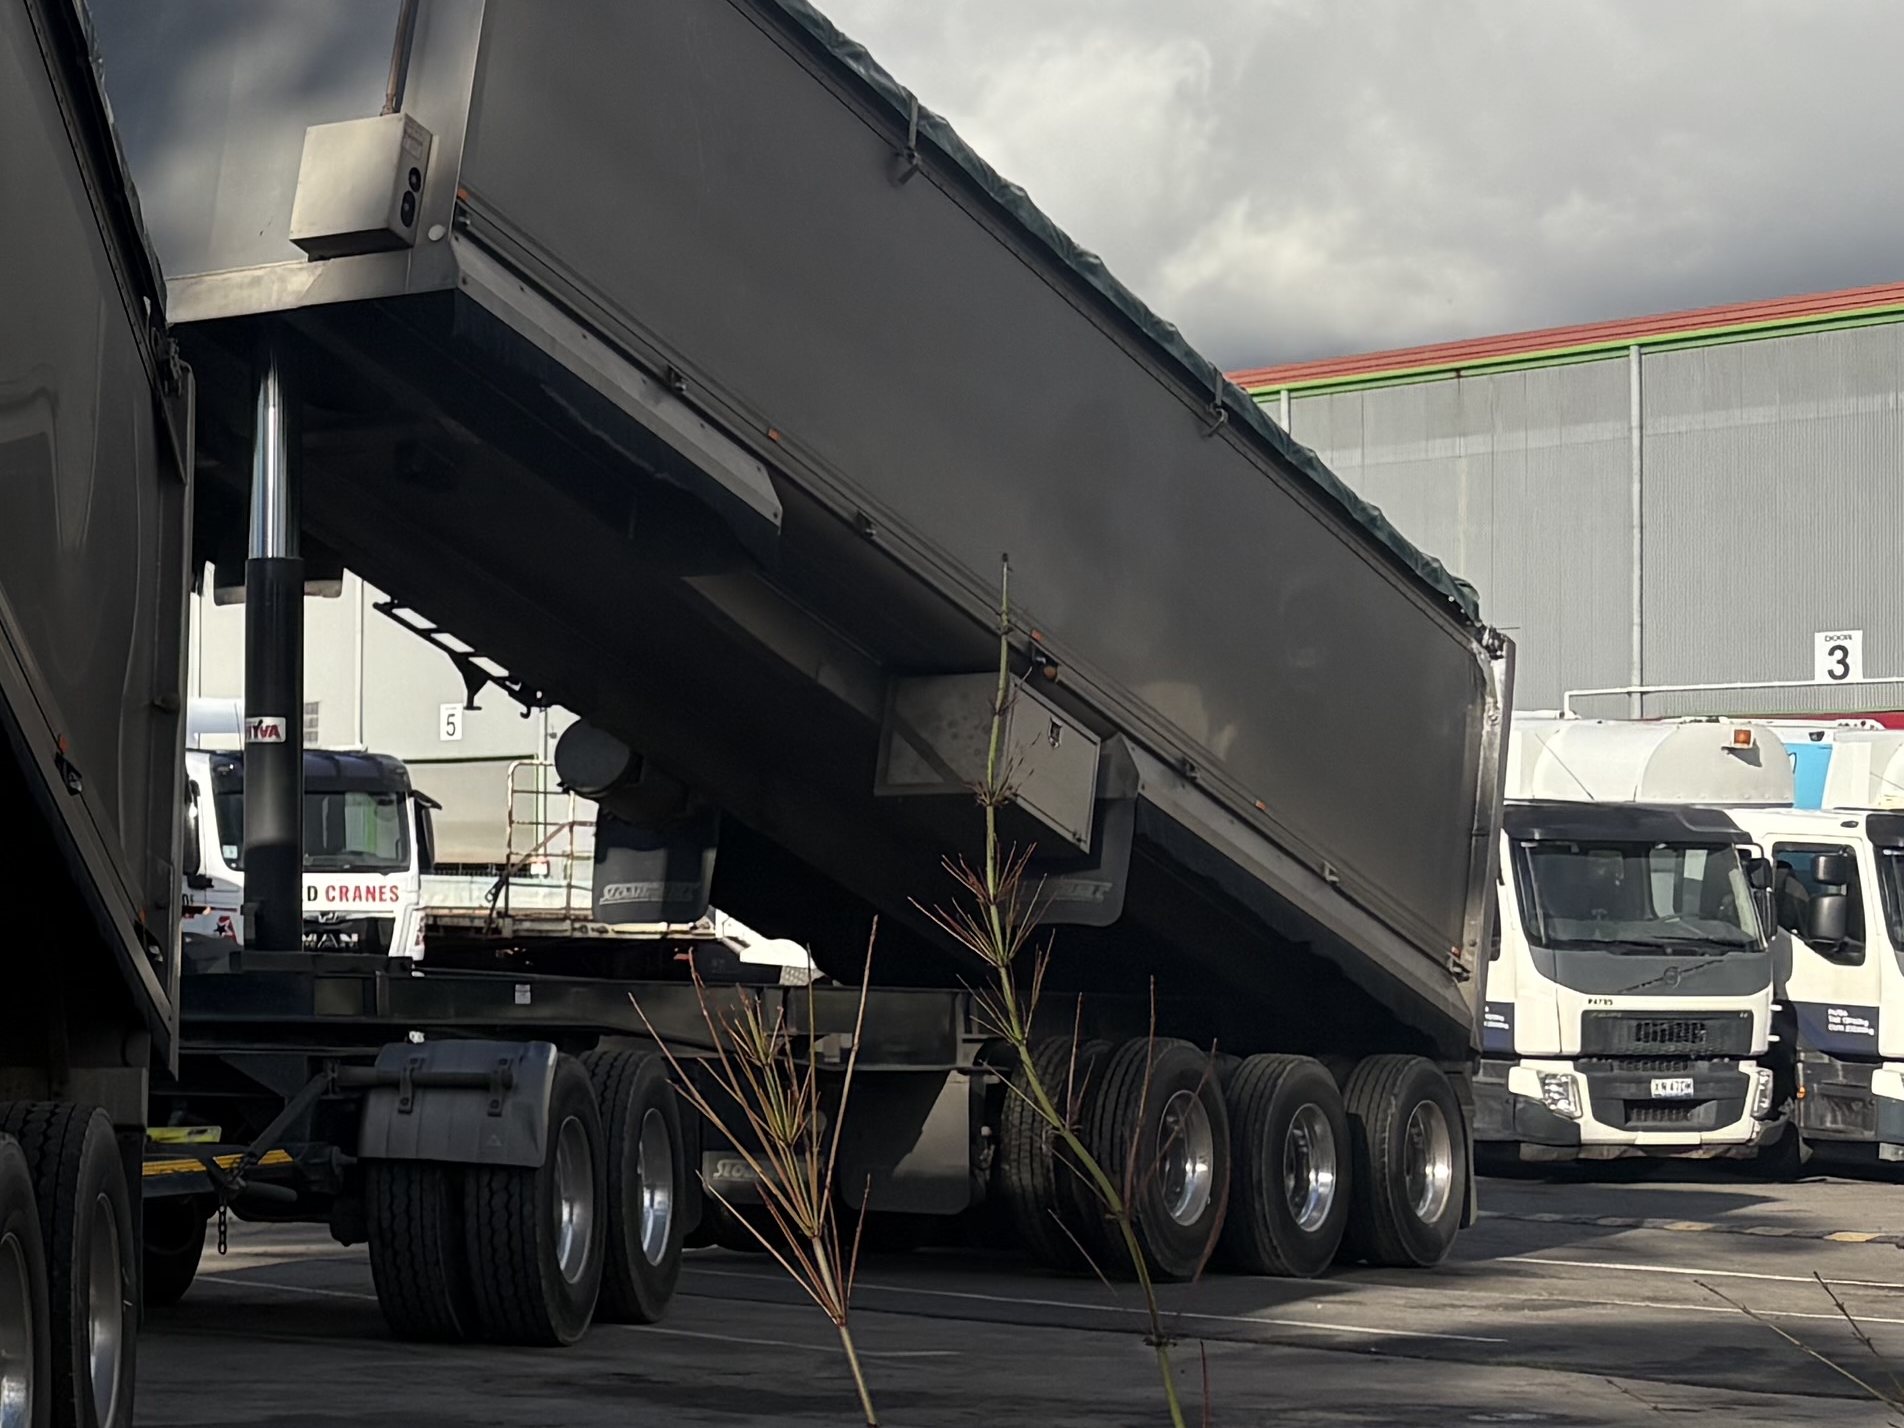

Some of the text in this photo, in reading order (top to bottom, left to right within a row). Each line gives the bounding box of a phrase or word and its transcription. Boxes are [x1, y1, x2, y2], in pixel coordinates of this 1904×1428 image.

[1827, 644, 1851, 681] 3
[445, 713, 456, 737] 5
[325, 884, 400, 903] CRANES
